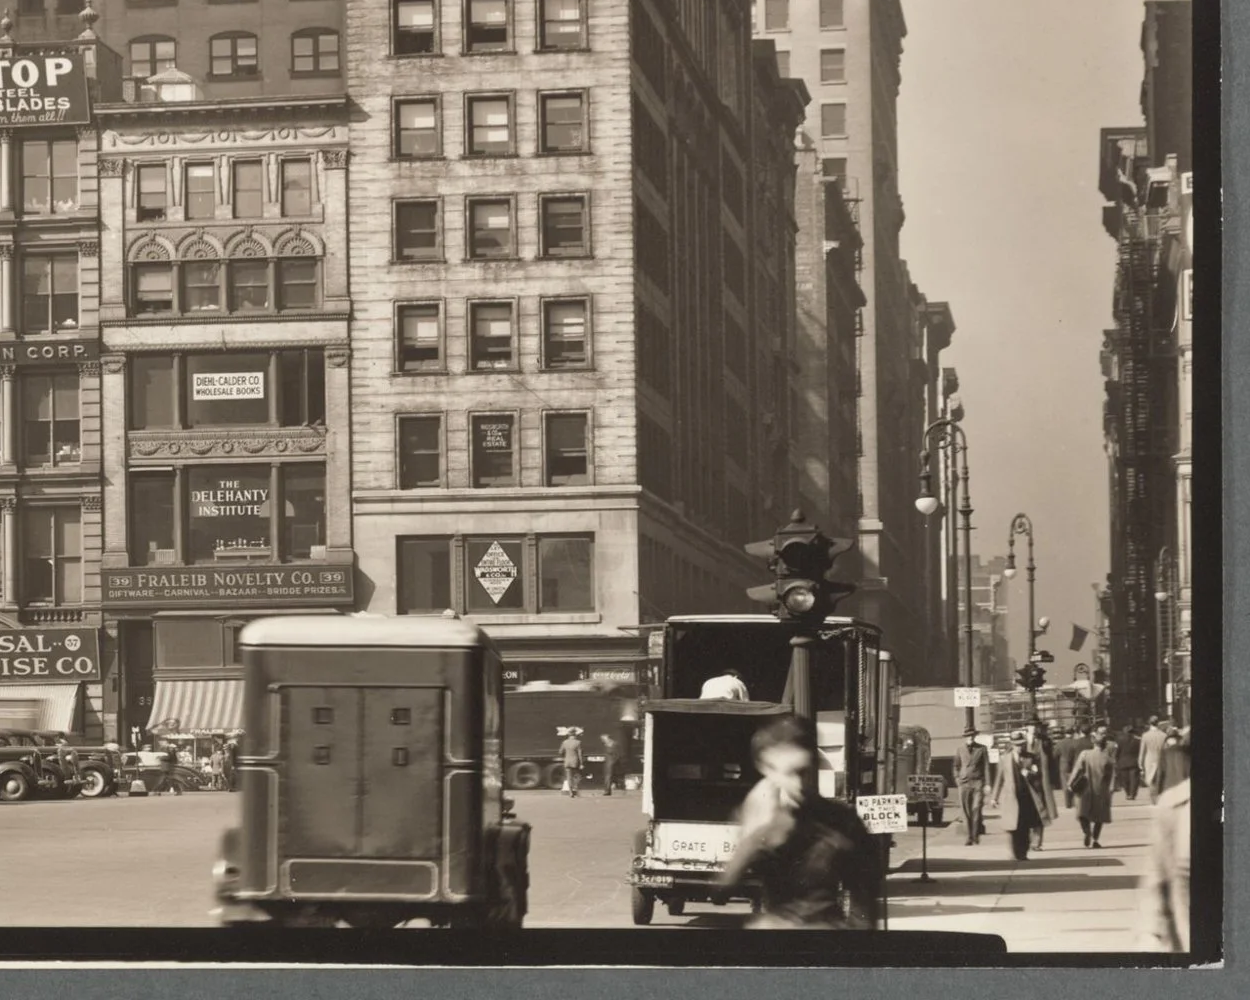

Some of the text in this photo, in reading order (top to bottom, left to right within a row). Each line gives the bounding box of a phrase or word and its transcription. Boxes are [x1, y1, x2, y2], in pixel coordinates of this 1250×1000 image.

[11, 111, 37, 124] them
[26, 344, 89, 359] CORP.
[196, 386, 261, 396] WHOLESALE BOOKS
[219, 480, 240, 488] THE
[191, 489, 268, 503] DELEHANTY
[198, 505, 261, 517] INSTITUTE
[111, 571, 342, 588] 39 FRALEIB NOVELTY CO. 39
[164, 588, 211, 597] CARNIVAL
[219, 587, 258, 596] BAZAAR
[267, 587, 301, 595] BRIDGE
[65, 637, 80, 649] 37
[56, 656, 97, 676] CO.
[858, 799, 869, 808] NO
[872, 796, 905, 806] PARKING
[863, 811, 901, 821] BLOCK
[671, 839, 707, 853] GRATE
